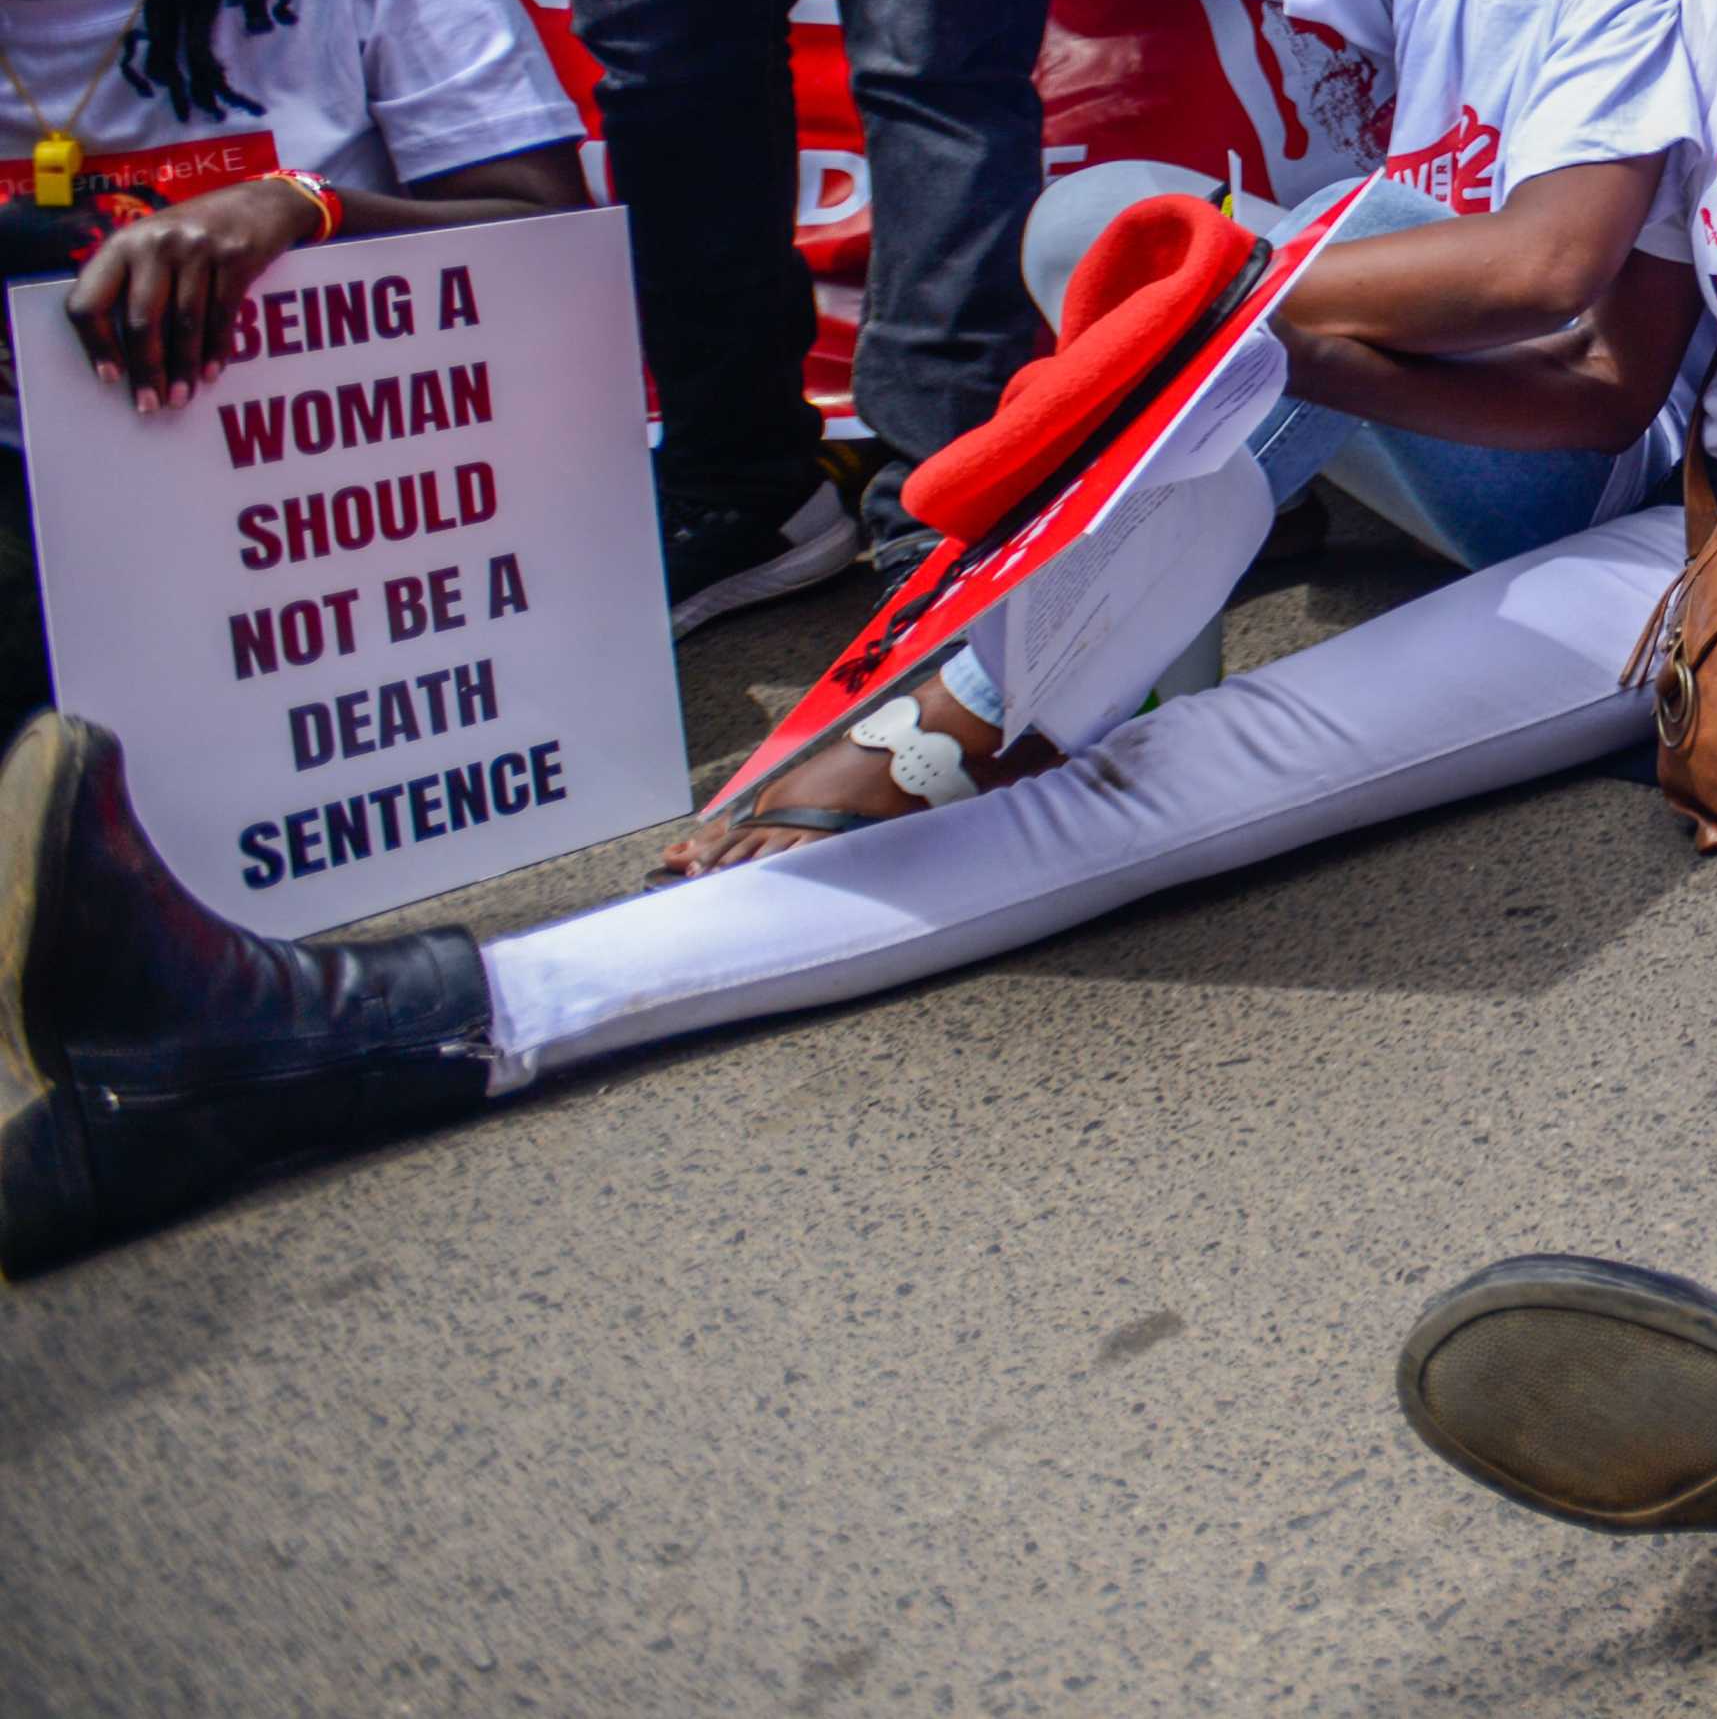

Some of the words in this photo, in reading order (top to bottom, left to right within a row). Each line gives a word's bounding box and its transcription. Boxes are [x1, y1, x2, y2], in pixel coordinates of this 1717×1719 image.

[226, 274, 415, 366] BEING
[438, 264, 481, 332] A
[218, 361, 494, 470] WOMAN
[237, 461, 498, 572] SHOULD
[228, 588, 360, 681] NOT
[384, 566, 467, 645] BE
[488, 552, 530, 620] A
[288, 656, 499, 773] DEATH
[237, 739, 567, 891] SENTENCE
